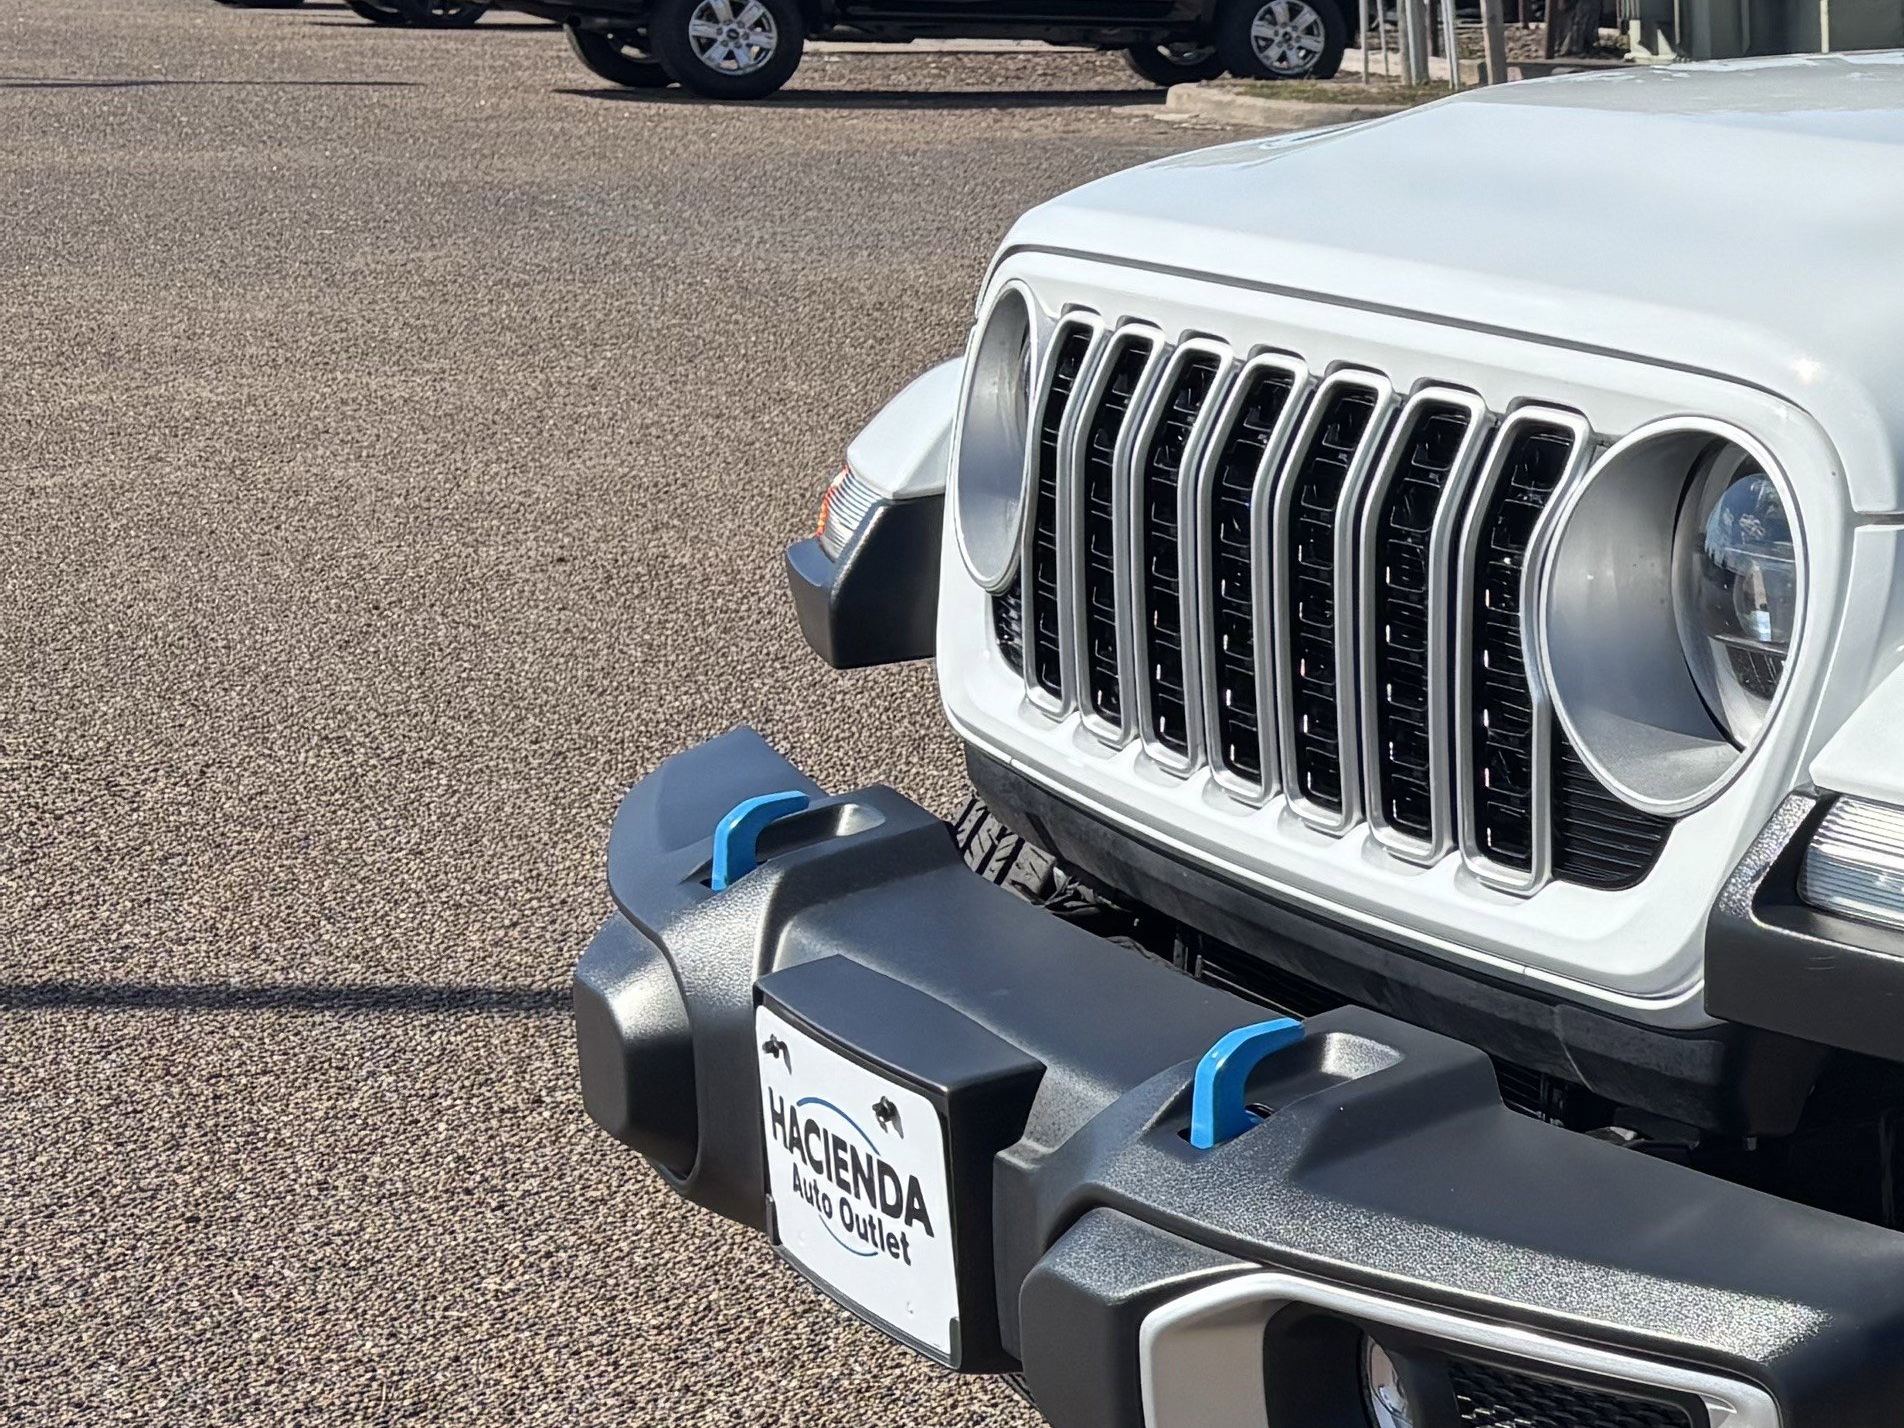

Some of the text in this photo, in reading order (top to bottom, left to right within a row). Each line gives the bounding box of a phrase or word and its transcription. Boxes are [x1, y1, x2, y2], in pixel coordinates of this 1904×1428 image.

[767, 1085, 935, 1239] HACIENDA
[792, 1162, 912, 1267] Auto Outlet
